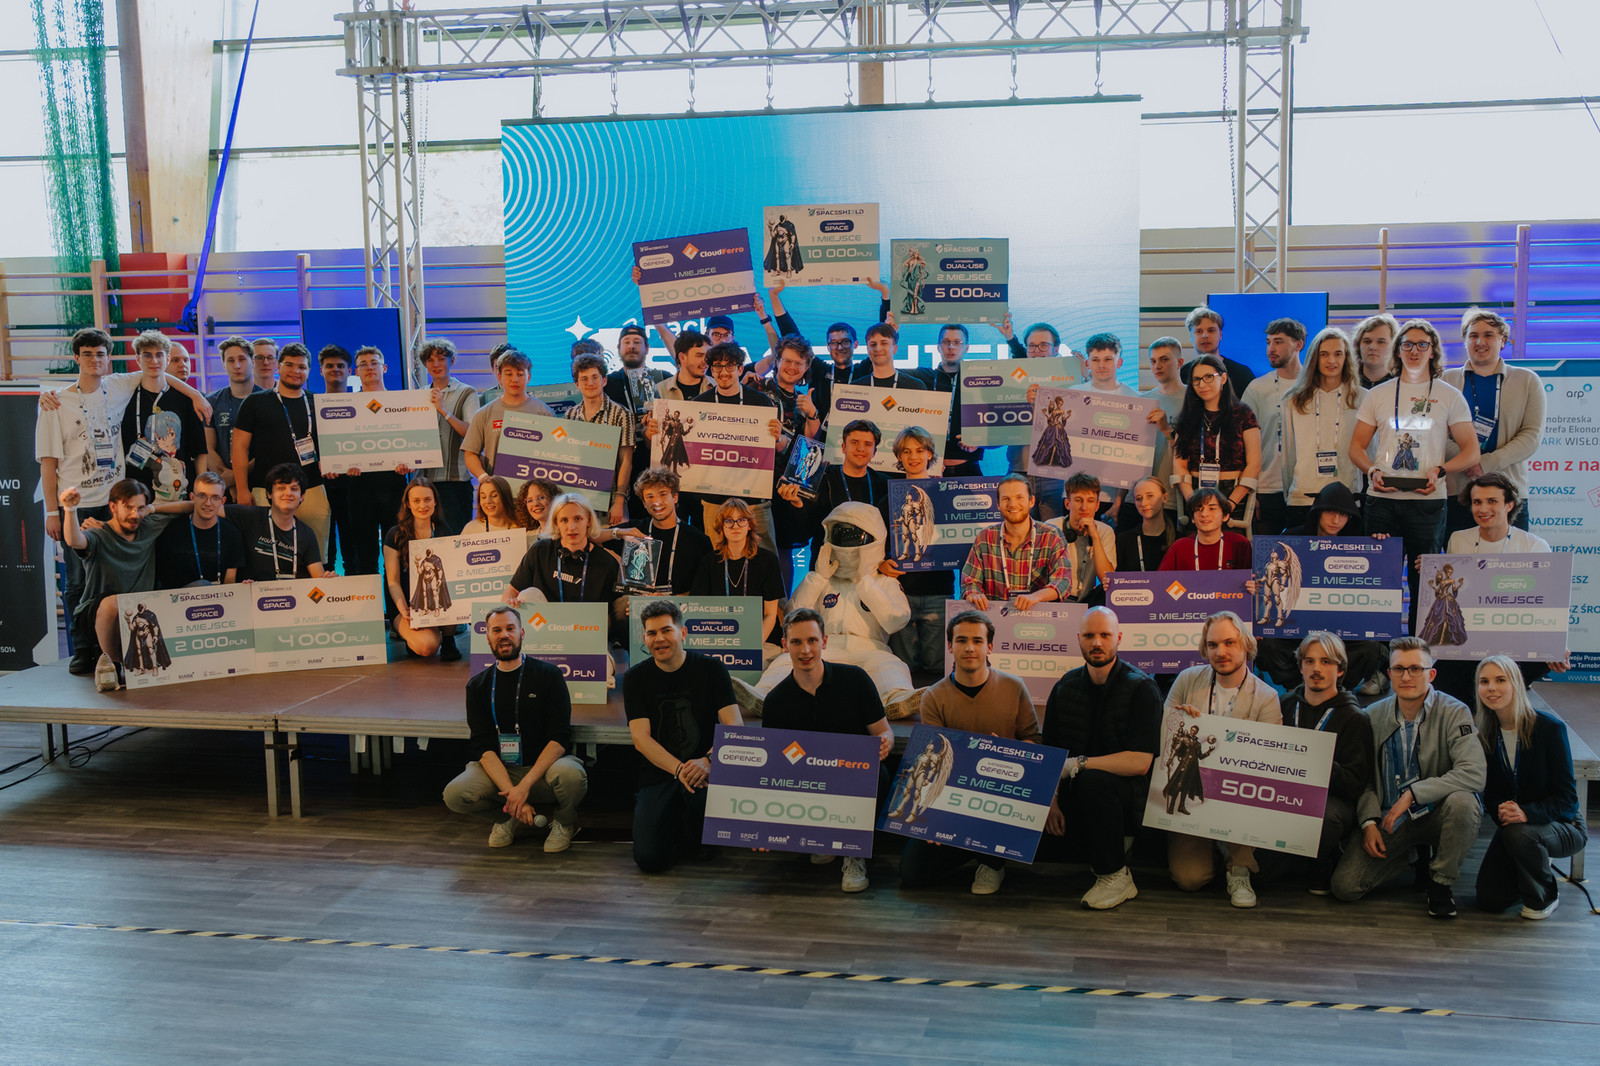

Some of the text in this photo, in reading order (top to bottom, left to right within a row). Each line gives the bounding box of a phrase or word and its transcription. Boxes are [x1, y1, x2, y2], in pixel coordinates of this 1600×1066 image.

[817, 234, 862, 242] MIEJSCE
[700, 246, 744, 258] CloudFerro
[808, 249, 822, 259] 10
[679, 267, 717, 278] MIEJSCE
[652, 289, 680, 302] 20
[934, 288, 946, 298] 5
[1566, 391, 1584, 400] arp
[897, 406, 942, 416] CloudFerro
[708, 416, 758, 424] SPACESHIELD
[977, 411, 998, 424] 10
[1546, 415, 1592, 424] nobrzeska
[1091, 428, 1138, 442] MIEJSCE
[1545, 426, 1566, 434] trefa
[696, 432, 760, 442] WYRÓŻNIENIE
[1541, 438, 1562, 446] ARK
[336, 440, 357, 452] 10
[567, 436, 612, 450] CloudFerro
[1081, 442, 1086, 453] 1
[516, 464, 530, 477] 3
[1564, 460, 1574, 472] z
[1578, 460, 1600, 472] na
[1528, 486, 1576, 495] ZYSKASZ
[950, 512, 1002, 520] MIEJSCE
[1528, 517, 1584, 526] NAJDZIESZ
[941, 528, 956, 538] 10
[462, 536, 511, 548] SPACESHIELD
[471, 556, 496, 564] SPACE
[1487, 561, 1550, 569] SPACESHIELD
[466, 564, 512, 576] MIEJSCE
[1312, 576, 1382, 586] 3 MIEJSCE
[455, 584, 466, 595] 5
[180, 592, 234, 602] SPACESHIELD
[326, 594, 376, 603] CloudFerro
[1187, 592, 1244, 600] CloudFerro
[1308, 593, 1322, 604] 2
[1478, 596, 1544, 604] 1 MIEJSCE
[263, 601, 292, 610] SPACE
[192, 611, 219, 620] SPACE
[302, 614, 345, 623] MIEJSCE
[1159, 612, 1208, 620] MIEJSCE
[1472, 614, 1485, 625] 5
[186, 620, 236, 632] MIEJSCE
[548, 624, 600, 632] CloudFerro
[1020, 629, 1048, 638] OPEN
[278, 635, 294, 648] 4
[689, 638, 740, 646] MIEJSCE
[1132, 633, 1148, 647] 3
[175, 642, 188, 652] 2
[1001, 642, 1068, 652] 2 MIEJSCE
[999, 658, 1011, 670] 2
[1236, 736, 1308, 752] SPACESHIELD
[979, 743, 1044, 761] SPACESHIELD
[723, 754, 762, 763] DEFENCE
[806, 757, 870, 770] CloudFerro
[980, 765, 1020, 778] DEFENCE
[1219, 756, 1308, 780] WYRÓŻNIENIE
[760, 777, 826, 790] 2 MIEJSCE
[958, 775, 1032, 798] 2 MIEJSCE
[948, 792, 964, 806] 5
[730, 798, 758, 815] 10
